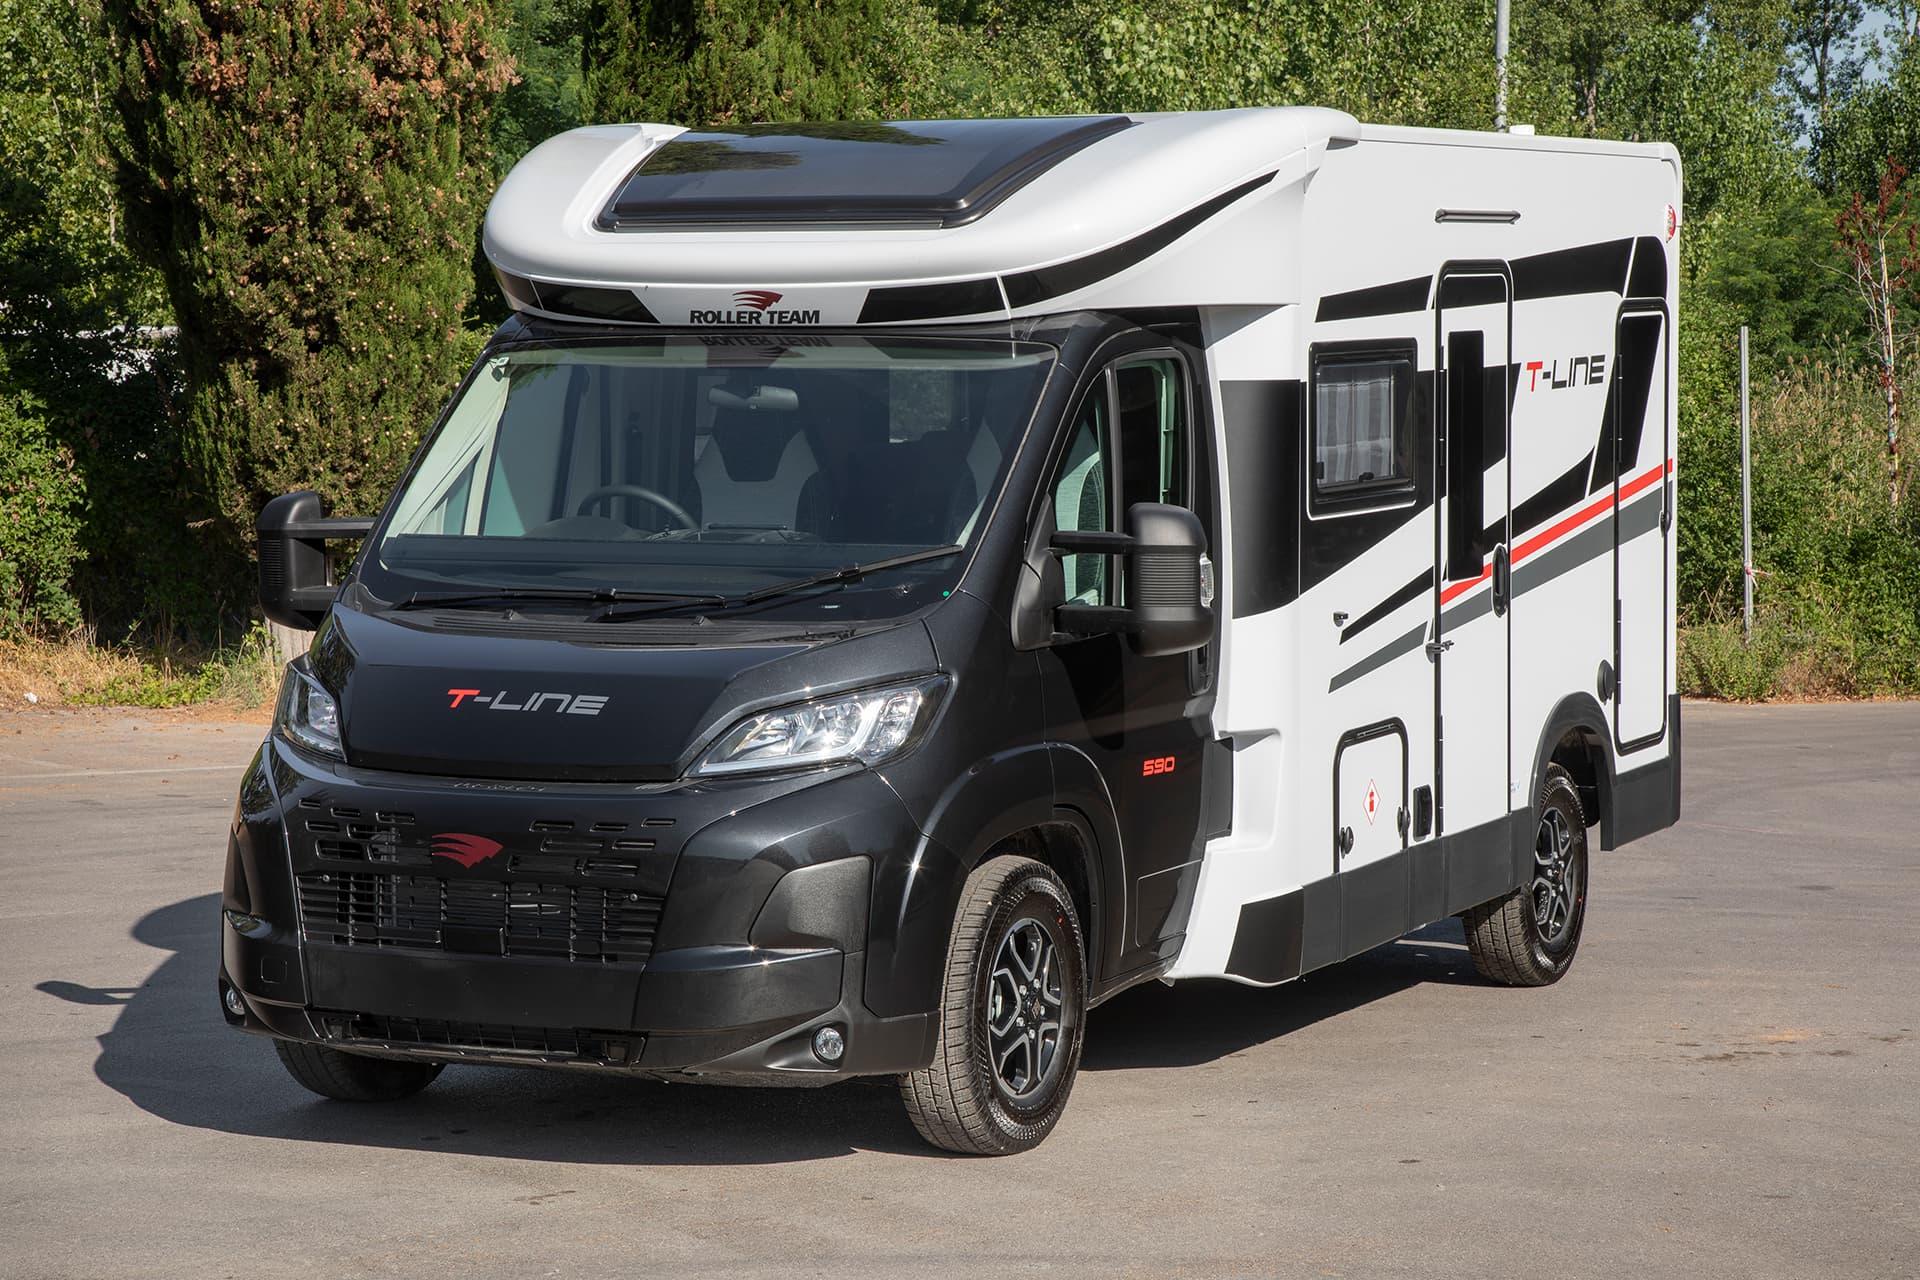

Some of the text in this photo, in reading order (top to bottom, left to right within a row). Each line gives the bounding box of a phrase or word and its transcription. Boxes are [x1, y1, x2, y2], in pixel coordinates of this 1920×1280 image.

[690, 310, 820, 324] ROLLER TEAM
[1526, 354, 1606, 392] T-LINE
[447, 689, 610, 716] T-LINE
[1142, 756, 1175, 777] 590
